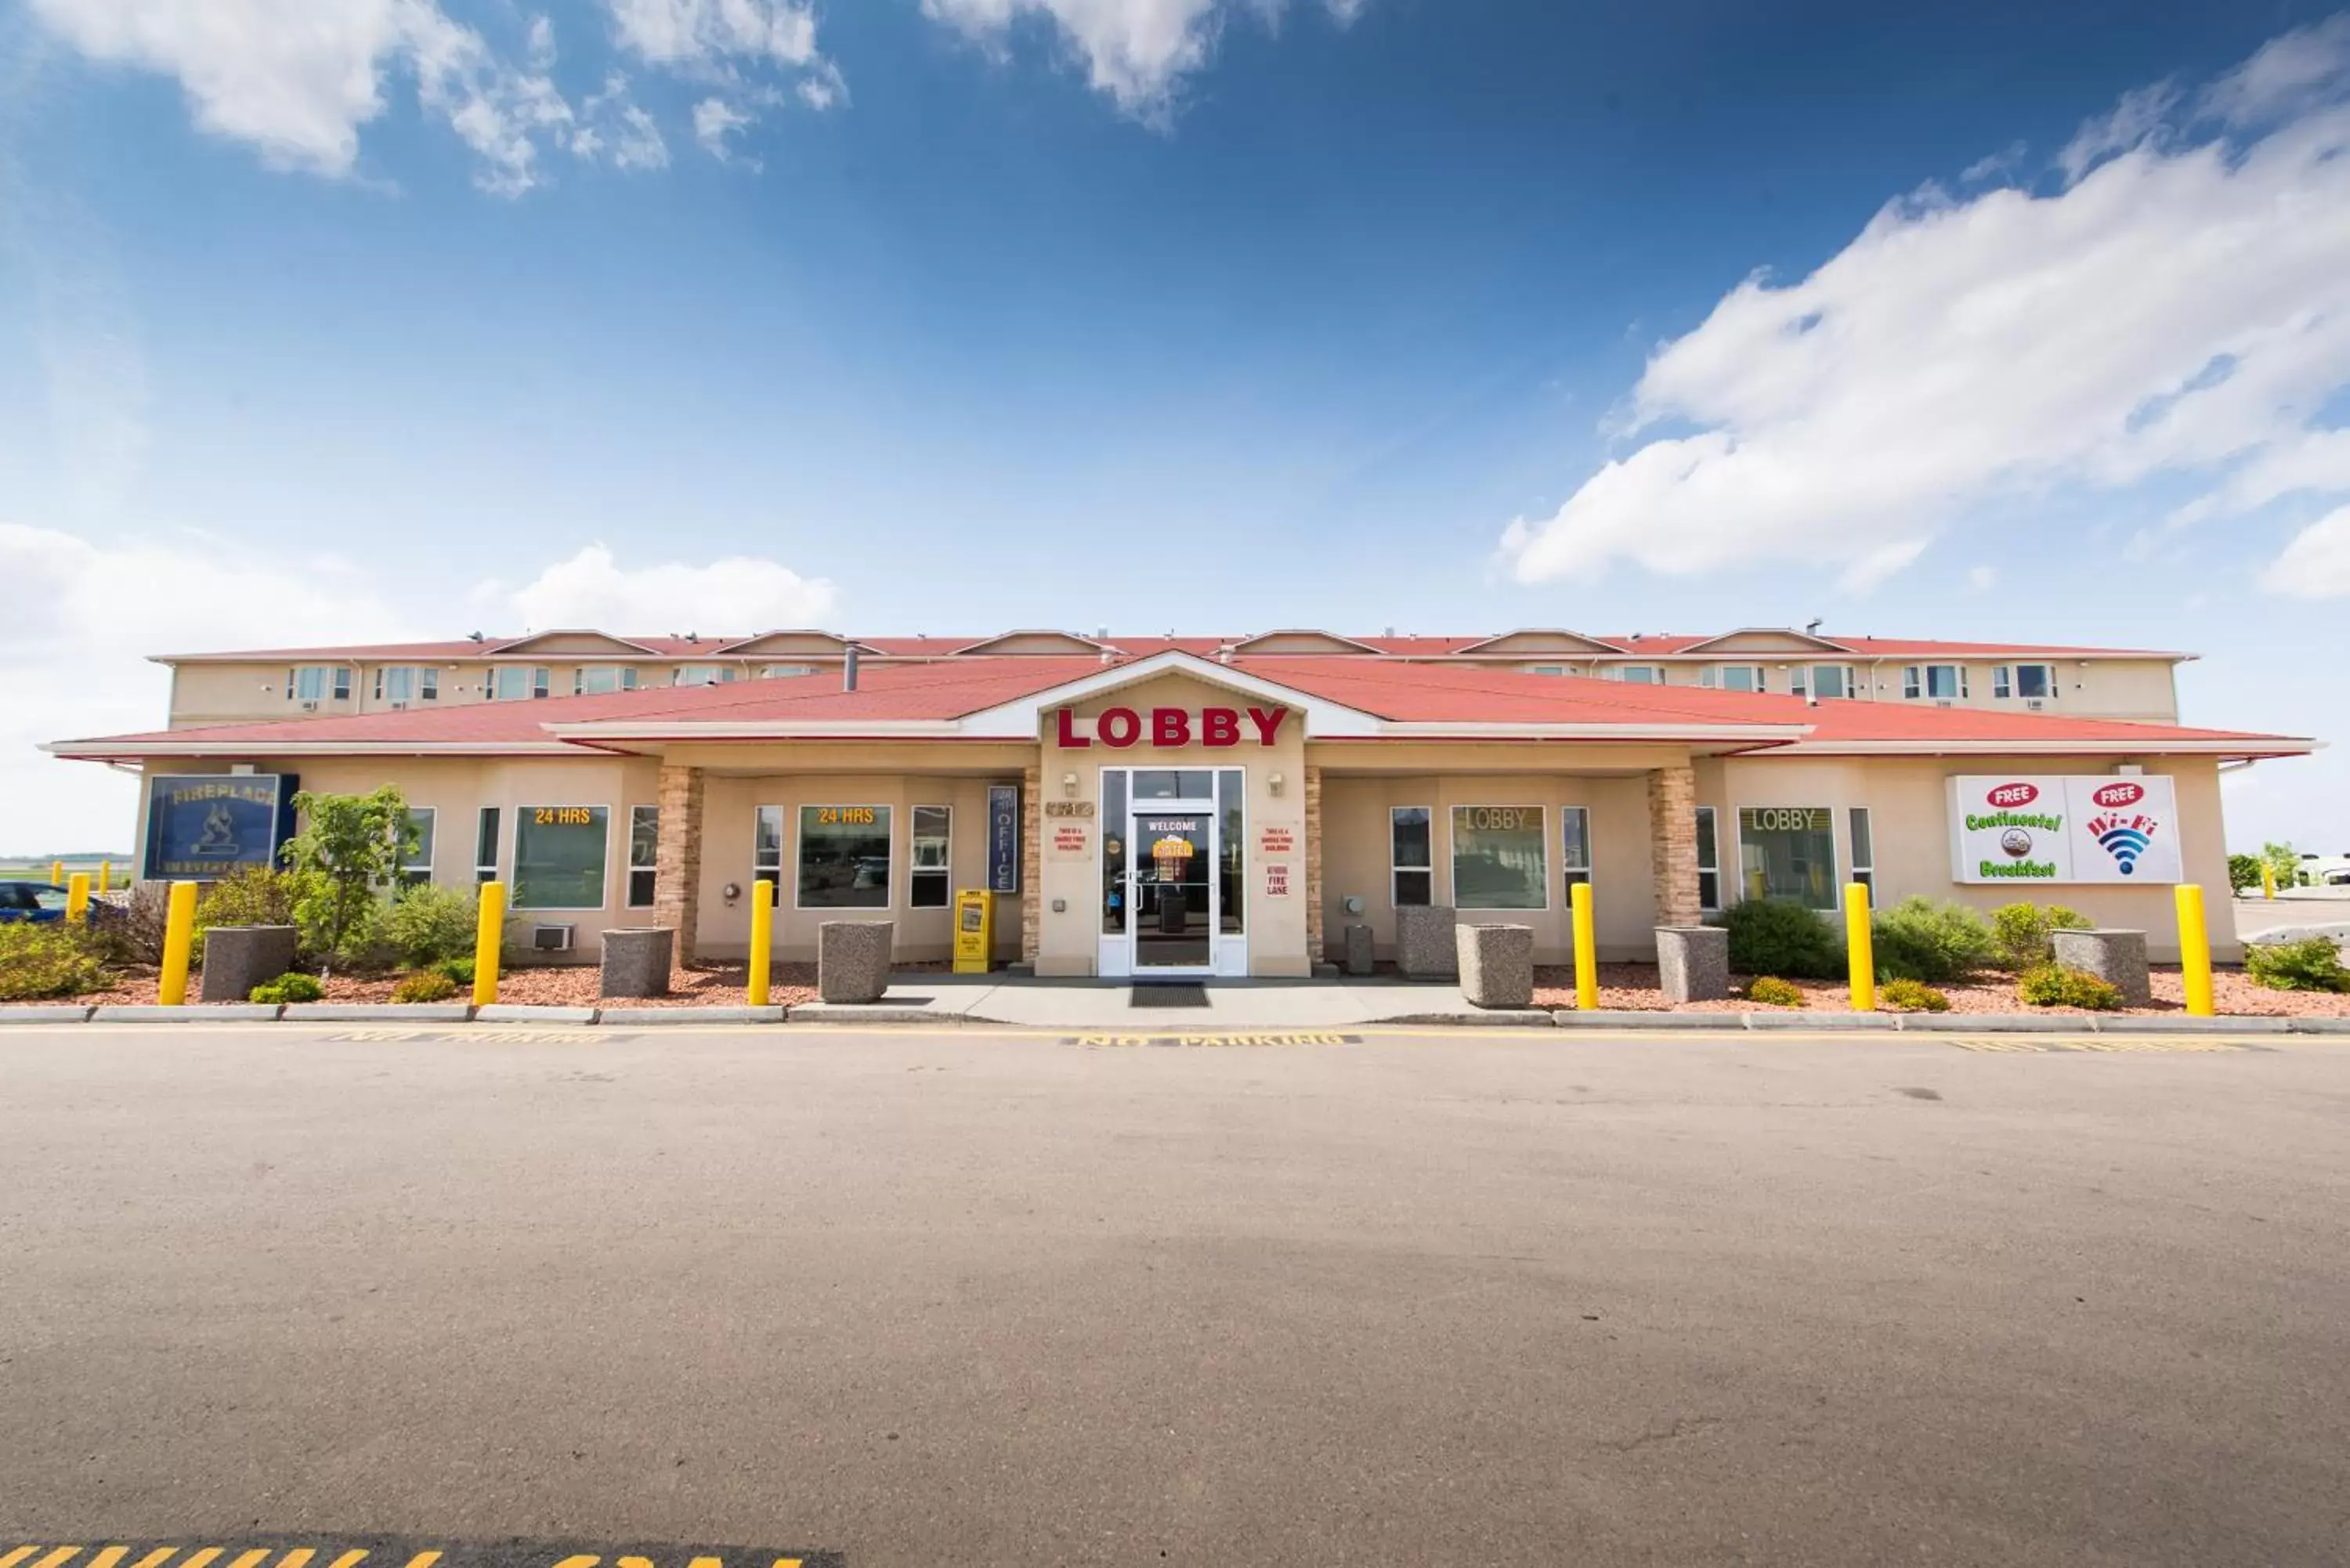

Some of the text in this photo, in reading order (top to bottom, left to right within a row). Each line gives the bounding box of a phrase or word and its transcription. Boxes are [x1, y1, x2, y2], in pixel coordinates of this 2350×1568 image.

[1058, 706, 1289, 747] LOBBY
[1994, 786, 2030, 804] FREE
[2100, 785, 2136, 804] FREE
[536, 807, 591, 824] 24 HRS
[819, 807, 874, 824] 24 HRS
[1466, 806, 1528, 829] LOBBY
[1753, 808, 1816, 829] LOBBY
[1966, 811, 2063, 832] Continental
[1148, 822, 1197, 831] WELCOME
[997, 814, 1011, 889] OFFICE
[1979, 859, 2057, 878] Breakfast
[1078, 1033, 1344, 1047] NO PARKING
